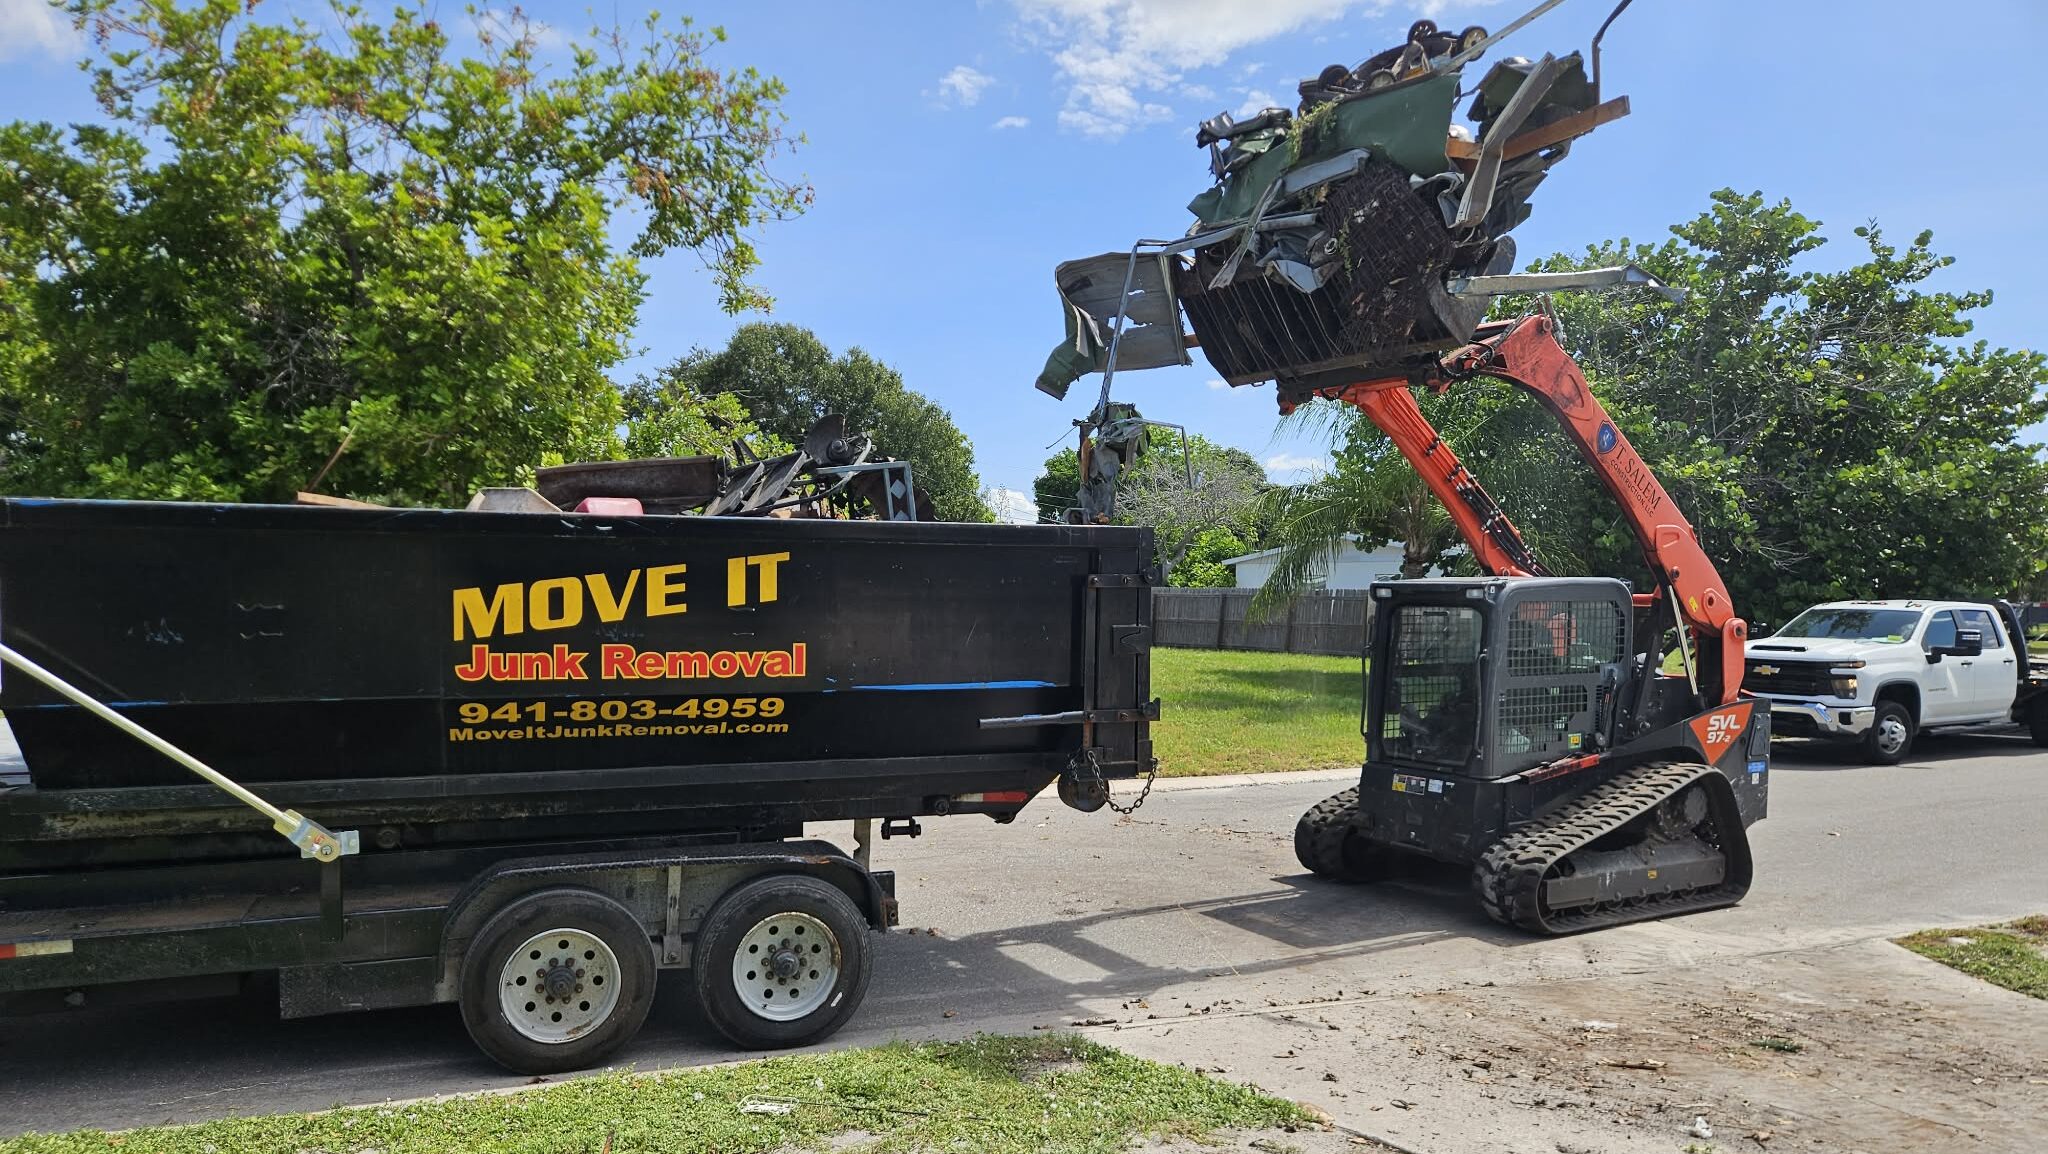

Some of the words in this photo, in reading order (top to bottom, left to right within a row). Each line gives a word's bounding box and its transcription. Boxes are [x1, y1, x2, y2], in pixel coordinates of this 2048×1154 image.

[1615, 444, 1627, 464] T.
[1624, 458, 1662, 510] SALEM
[1644, 505, 1654, 517] LLC
[452, 563, 687, 642] MOVE
[727, 551, 790, 607] IT
[454, 643, 589, 681] Junk
[601, 642, 807, 680] Removal
[458, 697, 785, 724] 941-803-4959
[1706, 714, 1741, 731] SVL
[449, 721, 789, 742] MoveItJunkRemoval.com
[1706, 730, 1731, 744] 97-2
